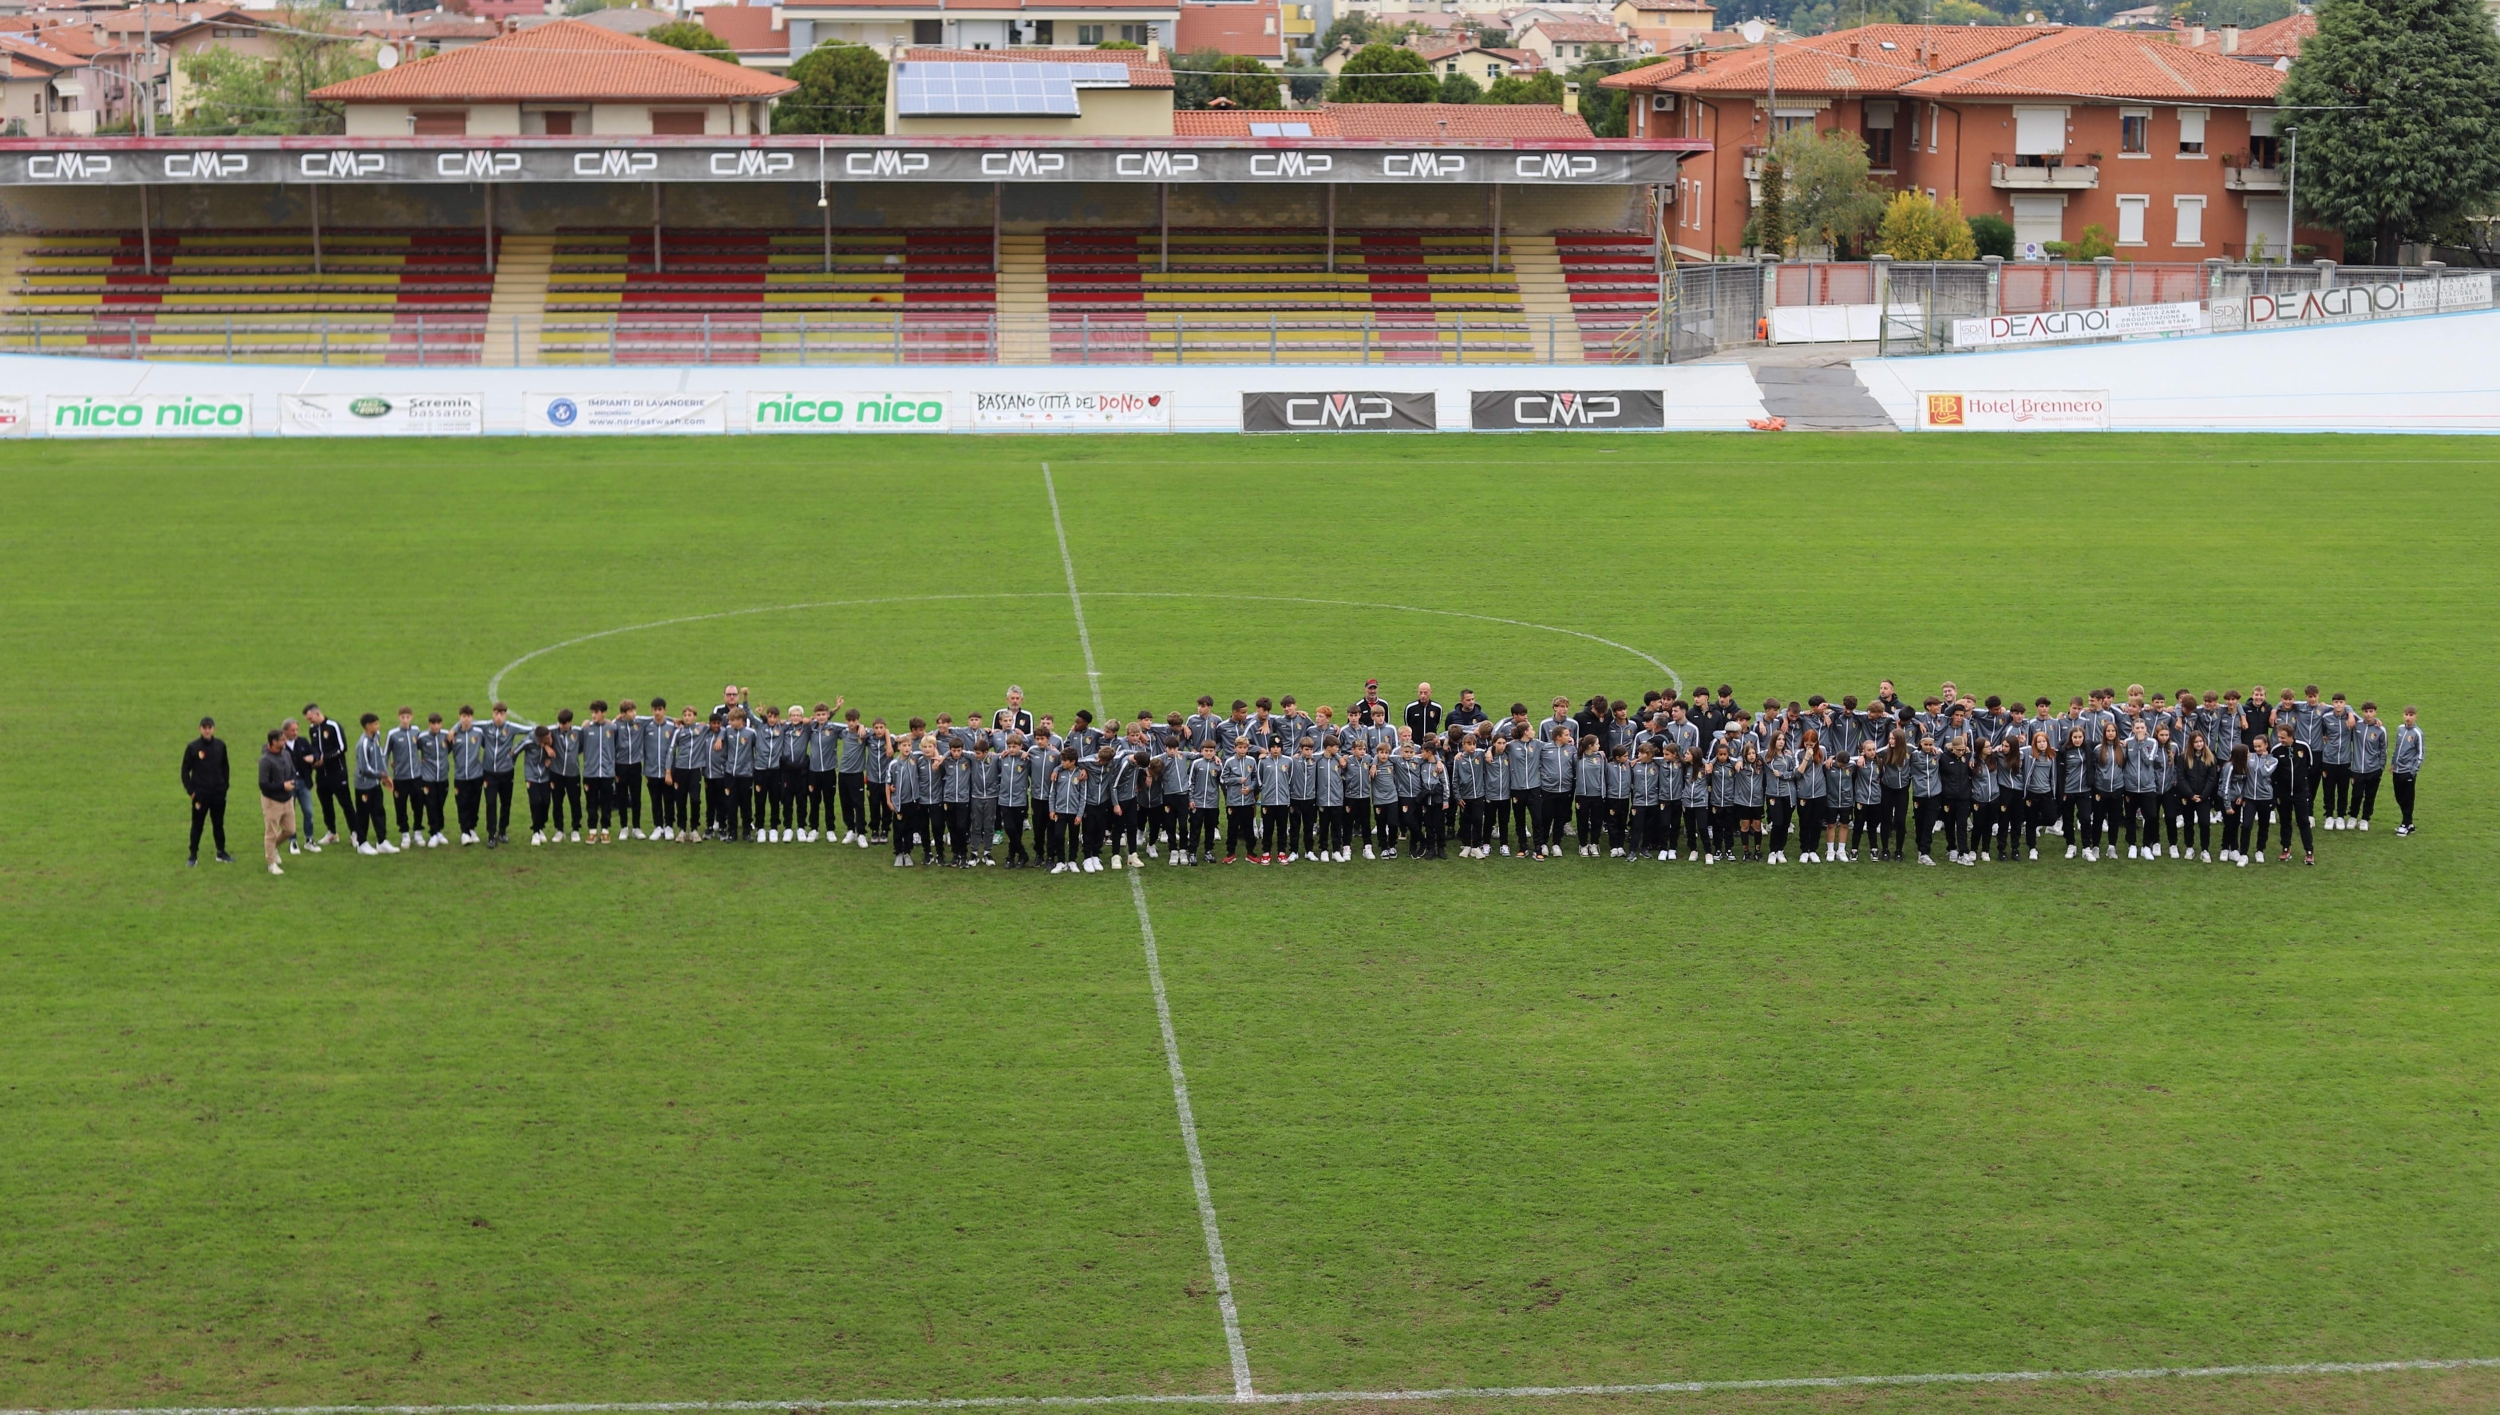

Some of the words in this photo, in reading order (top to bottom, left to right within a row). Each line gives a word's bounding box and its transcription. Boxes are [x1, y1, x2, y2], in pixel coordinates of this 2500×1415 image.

[28, 153, 112, 179] CMP
[164, 152, 248, 178] CMP
[301, 151, 385, 178] CMP
[437, 151, 521, 177] CMP
[573, 151, 657, 177] CMP
[710, 150, 794, 177] CMP
[846, 150, 929, 177] CMP
[981, 150, 1064, 177] CMP
[1116, 151, 1198, 177] CMP
[1250, 152, 1332, 177] CMP
[1383, 152, 1465, 178] CMP
[1516, 153, 1597, 179] CMP
[2414, 285, 2454, 293] TECNCO
[2419, 276, 2479, 286] STAPAGGIO
[2418, 289, 2472, 300] PROGTTAZIONE
[2122, 314, 2181, 322] PROGETTAZIONE
[2131, 304, 2177, 312] STAMPAGGIO
[2357, 313, 2402, 321] CATING
[55, 397, 143, 426] nico
[155, 396, 243, 426] nico
[408, 407, 471, 418] bassano
[410, 397, 471, 407] Scremin
[588, 399, 630, 407] IMPIANTI
[634, 399, 644, 407] DI
[646, 399, 705, 407] LAVANDERIE
[757, 393, 843, 422] nico
[856, 393, 942, 422] nico
[978, 394, 1035, 411] BASSANO
[1076, 395, 1096, 410] DEL
[1099, 393, 1144, 413] DONO
[1286, 393, 1392, 427] CMP
[1514, 393, 1620, 426] CMP
[1930, 398, 1958, 413] HB
[1969, 398, 2015, 413] Hotel
[2022, 399, 2103, 413] Brennero
